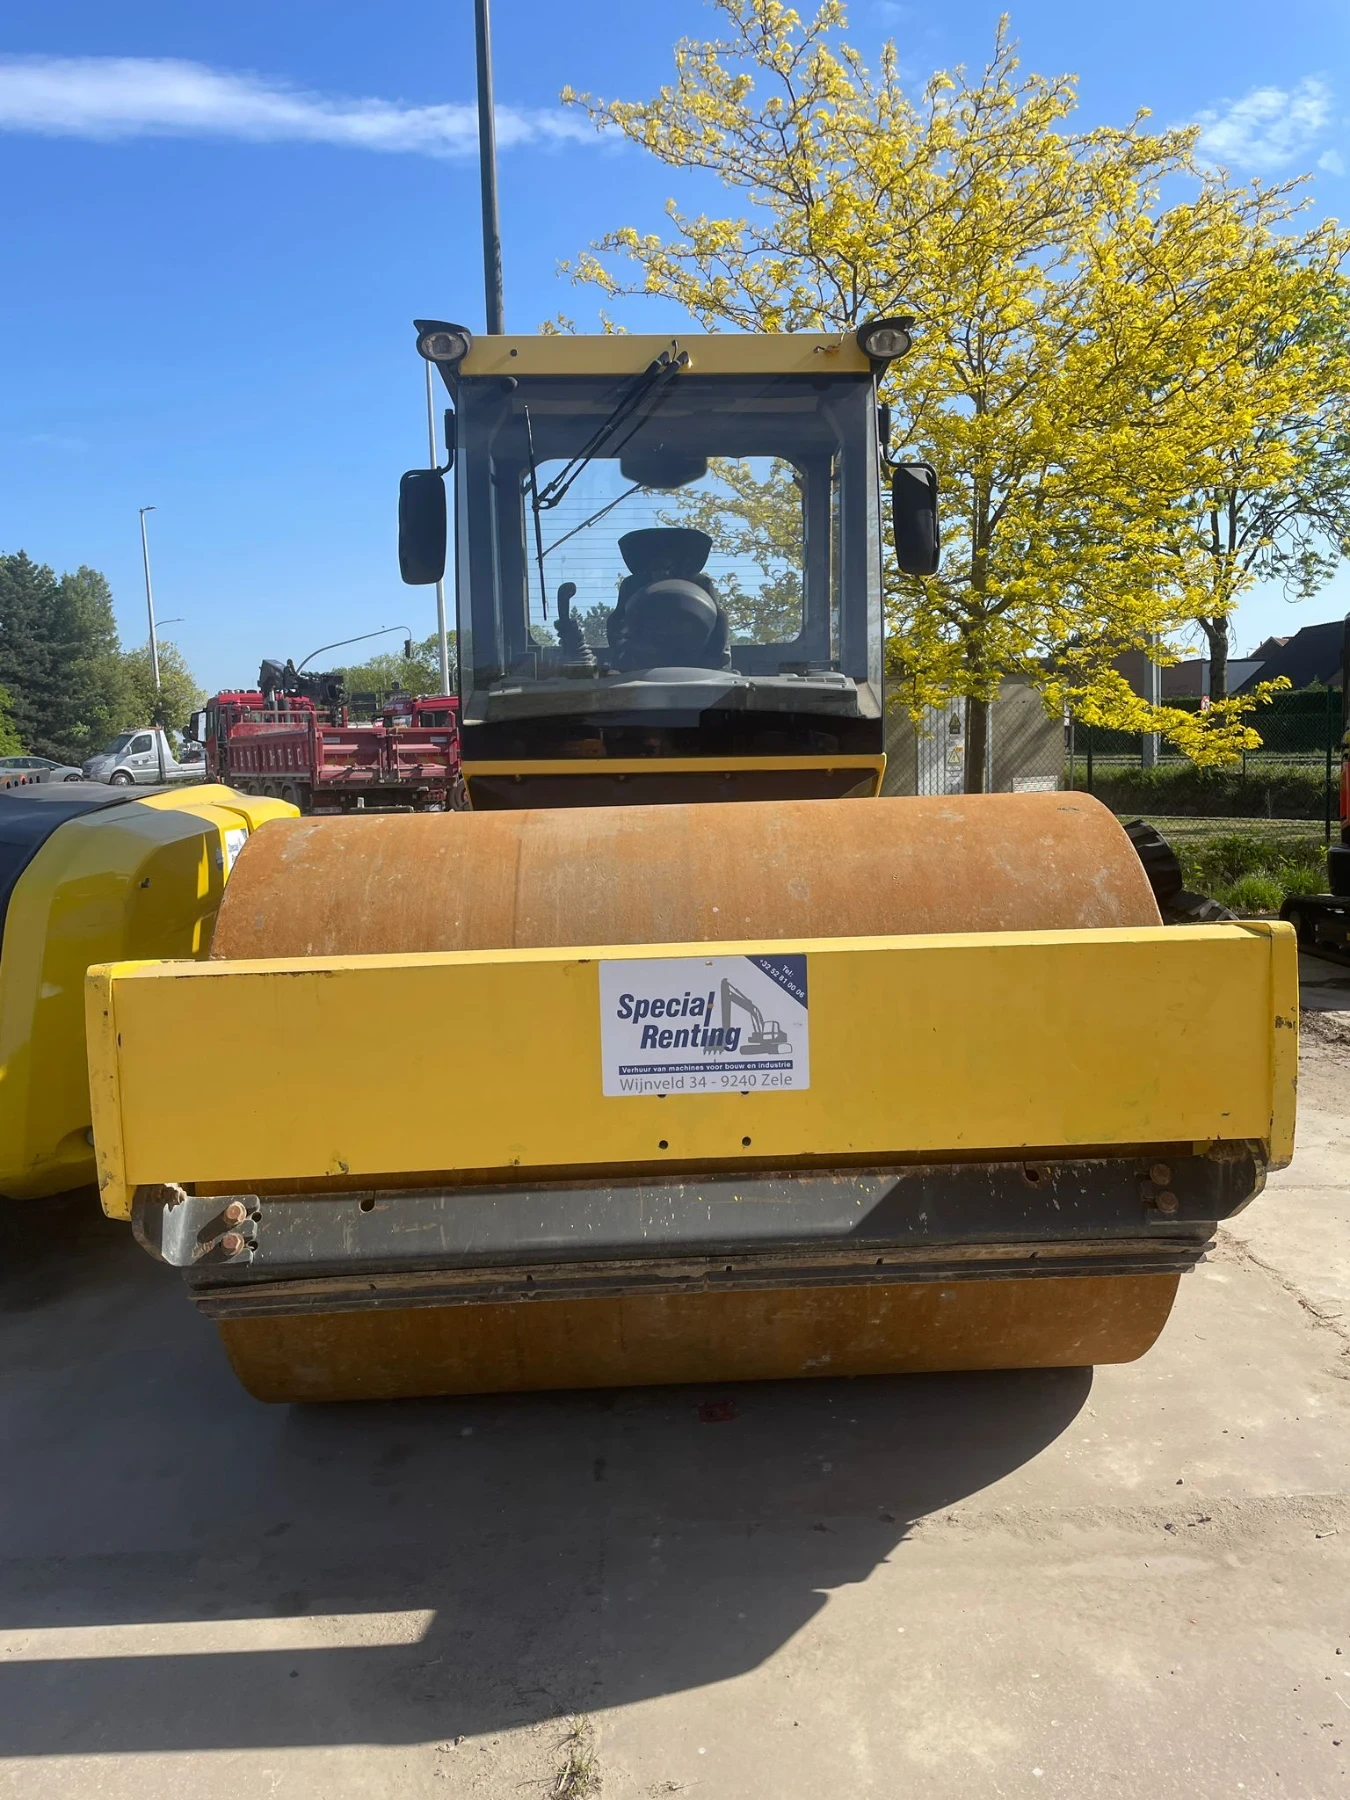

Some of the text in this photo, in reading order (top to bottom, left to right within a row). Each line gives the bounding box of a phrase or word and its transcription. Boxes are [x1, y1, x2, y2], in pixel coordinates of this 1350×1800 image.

[759, 959, 805, 998] +32 52 81 00 06
[782, 964, 794, 978] Tel:
[617, 991, 715, 1027] Special
[640, 1024, 742, 1052] Renting
[622, 1066, 651, 1074] Verhuur
[668, 1064, 704, 1072] machines
[725, 1062, 745, 1070] bouw
[758, 1061, 791, 1069] industrie
[620, 1076, 684, 1093] Wijnveld
[689, 1076, 706, 1088] 34
[721, 1074, 757, 1087] 9240
[761, 1072, 792, 1086] Zele
